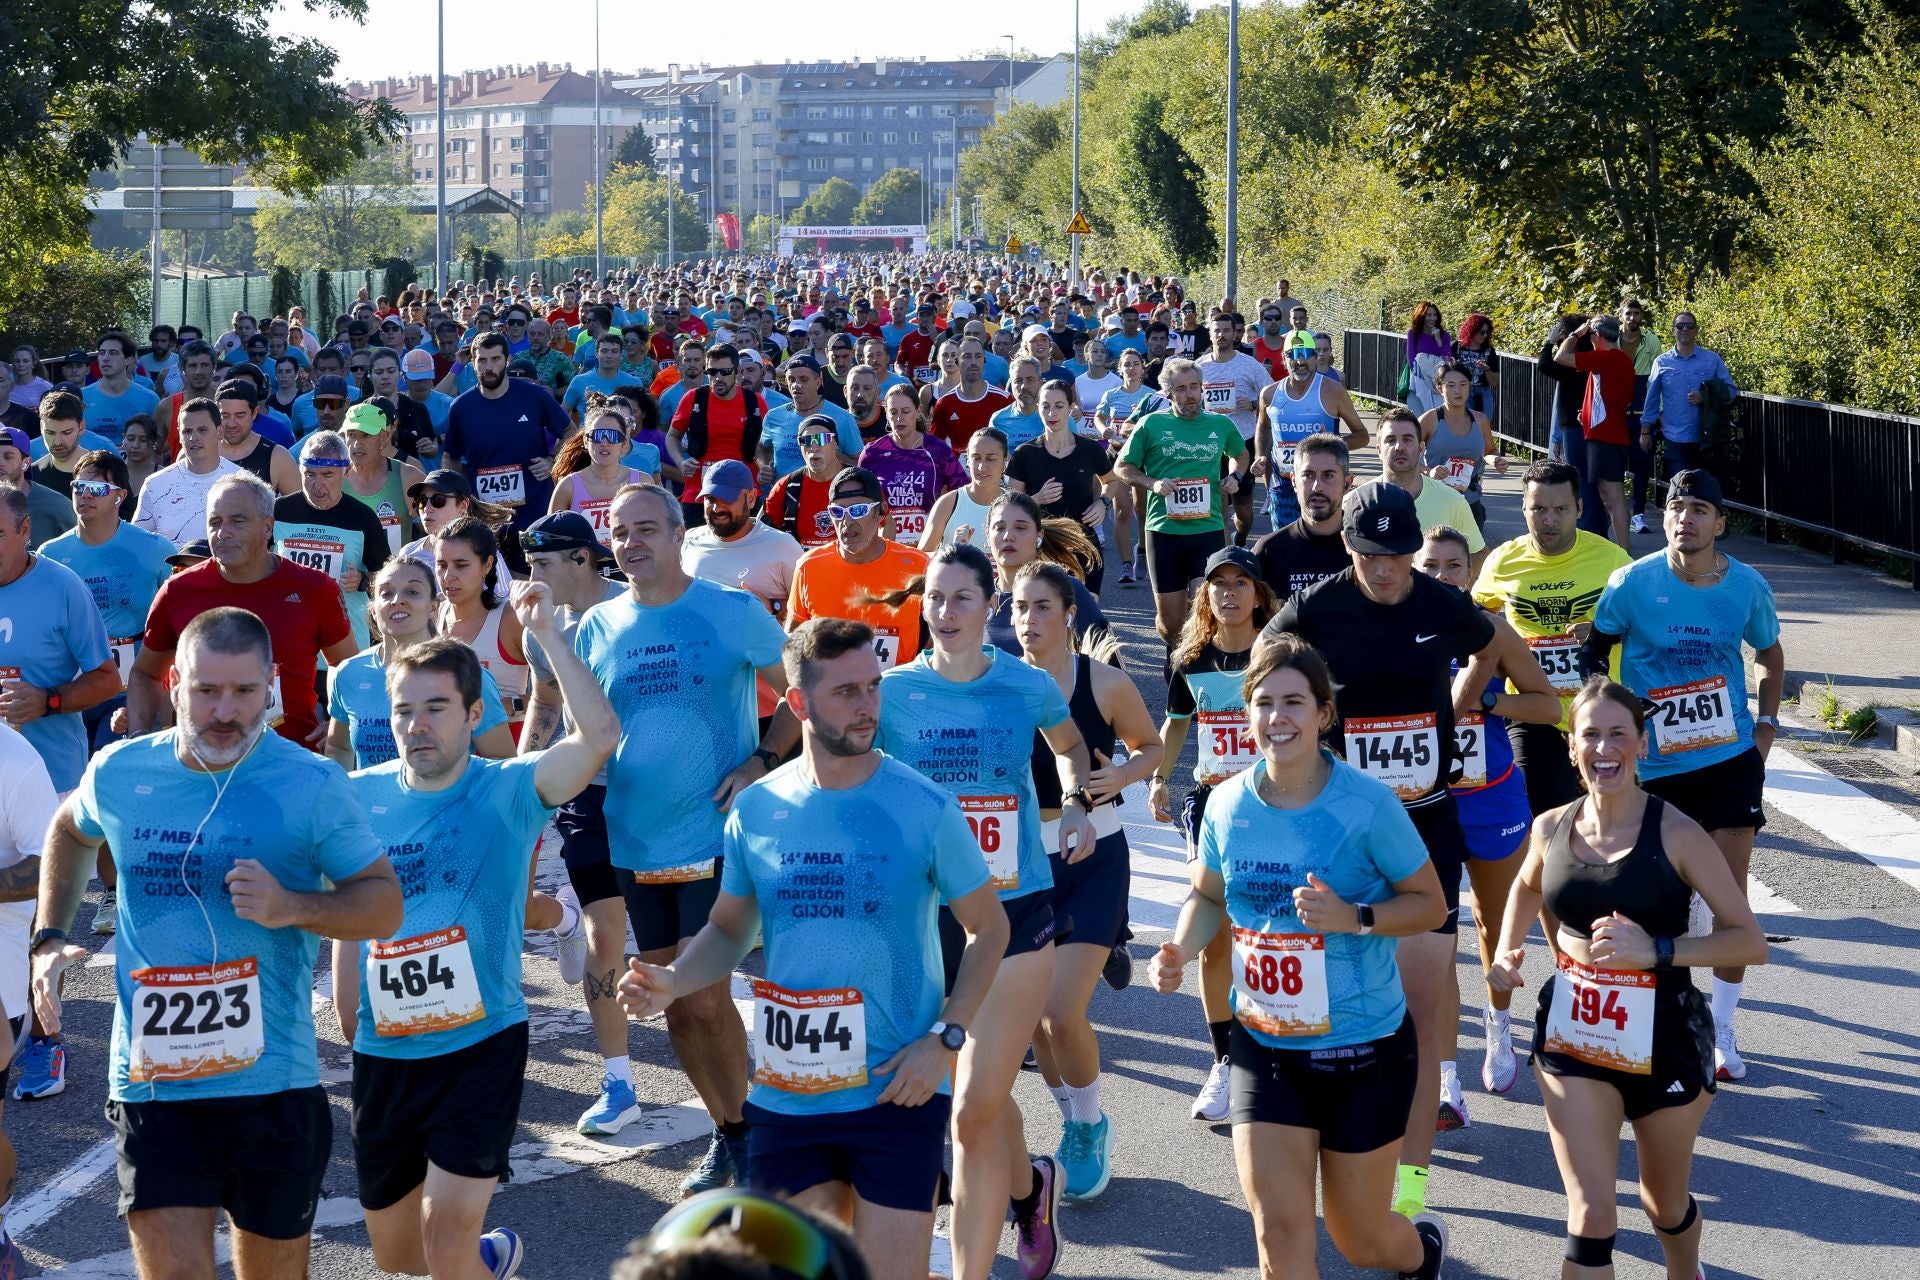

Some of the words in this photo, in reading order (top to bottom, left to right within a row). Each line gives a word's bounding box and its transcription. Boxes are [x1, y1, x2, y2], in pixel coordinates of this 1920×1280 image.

[829, 228, 851, 236] media
[854, 227, 888, 236] maratón
[1206, 389, 1231, 402] 2317
[480, 473, 520, 494] 2497
[903, 470, 925, 488] 44
[887, 486, 916, 497] VILLA
[1173, 486, 1204, 504] 1881
[290, 550, 332, 574] 1081
[1290, 574, 1315, 582] XXXV
[1530, 580, 1577, 591] WOLVES
[1540, 598, 1566, 607] BORN
[1549, 606, 1560, 614] TO
[1544, 614, 1570, 624] RUN
[1684, 626, 1711, 636] MBA
[1678, 639, 1711, 648] media
[626, 648, 643, 659] 14ª
[644, 644, 676, 656] MBA
[638, 657, 678, 671] media
[1532, 648, 1581, 676] 533
[1660, 692, 1724, 727] 2461
[918, 729, 938, 740] 14ª
[940, 728, 977, 739] MBA
[1212, 728, 1257, 757] 314
[932, 744, 979, 756] media
[1354, 732, 1430, 770] 1445
[932, 769, 978, 783] GIJÓN
[1501, 821, 1526, 836] Joma
[132, 828, 158, 841] 14ª
[160, 830, 204, 846] MBA
[388, 842, 425, 857] MBA
[147, 850, 202, 866] media
[780, 852, 800, 866] 14ª
[803, 852, 844, 865] MBA
[1234, 860, 1254, 872] 14ª
[1255, 862, 1292, 875] MBA
[794, 871, 844, 886] media
[778, 886, 845, 900] maratón
[1247, 880, 1292, 893] media
[792, 901, 845, 918] GIJÓN
[424, 935, 448, 947] GIJÓN
[1282, 937, 1306, 946] GIJÓN
[169, 972, 194, 982] MBA
[215, 968, 240, 980] GIJÓN
[380, 954, 455, 1000] 464
[1245, 953, 1304, 996] 688
[1615, 974, 1638, 983] GIJÓN
[818, 994, 844, 1002] GIJÓN
[142, 984, 250, 1036] 2223
[399, 1003, 424, 1012] ALFREDO
[424, 1000, 445, 1008] RAMOS
[1571, 982, 1628, 1031] 194
[764, 1005, 852, 1054] 1044
[1575, 1029, 1595, 1038] ESTHER
[1310, 1050, 1337, 1060] SENCILLO
[1338, 1048, 1356, 1058] ENTRE
